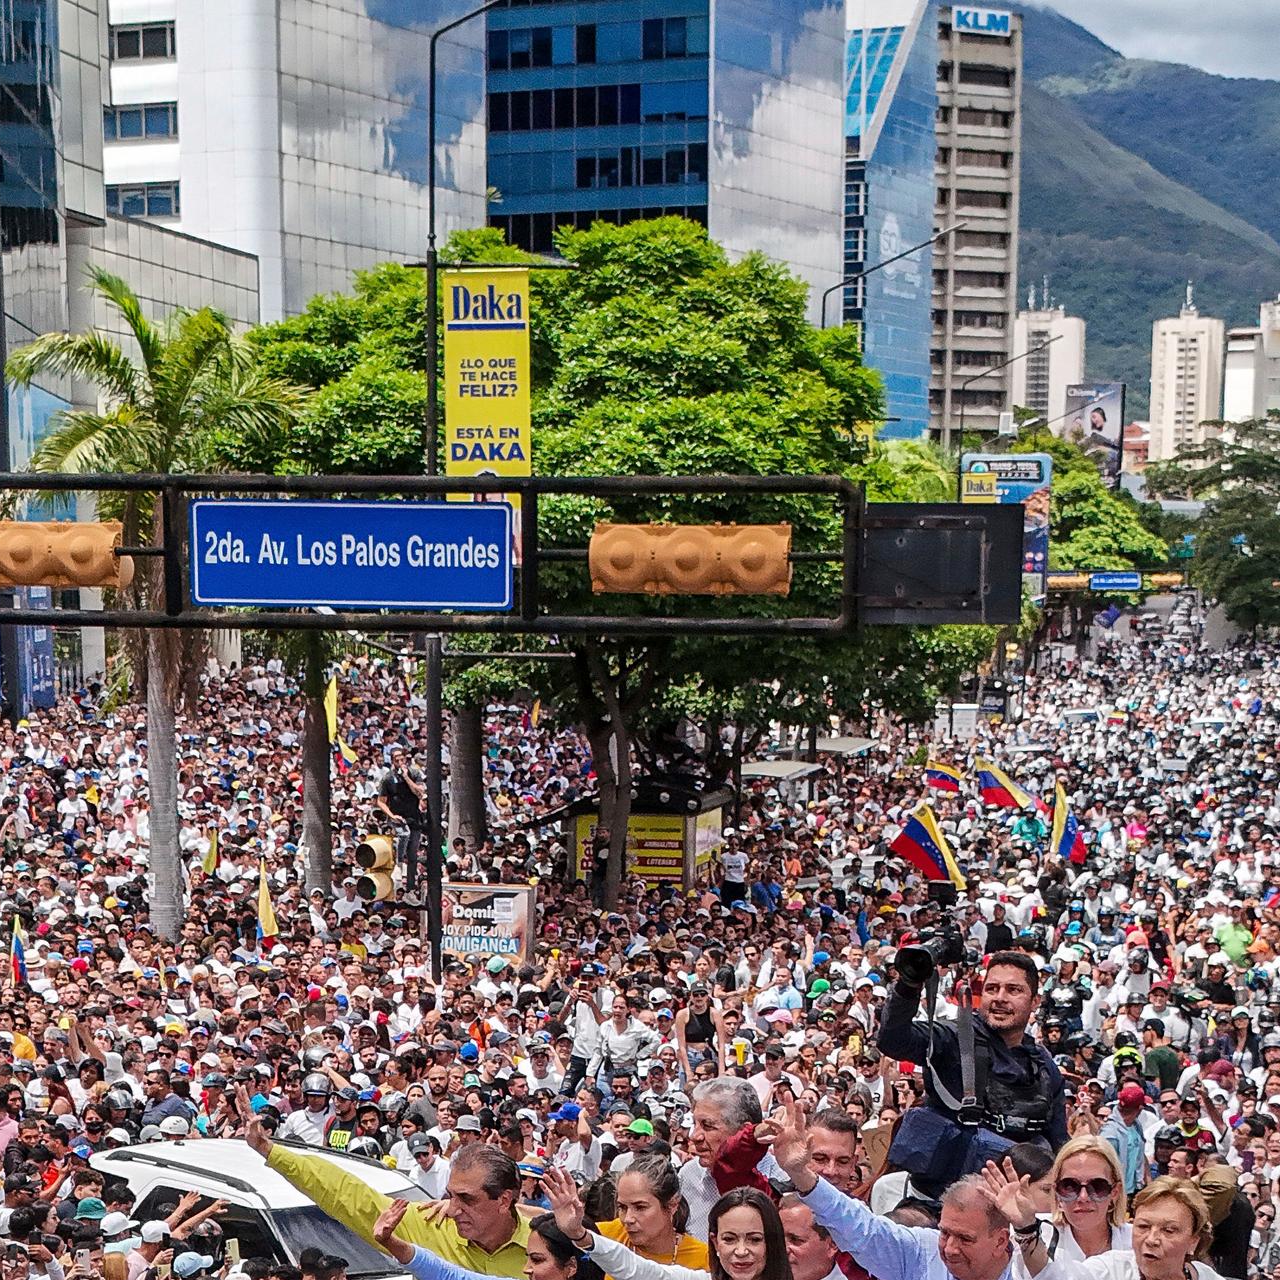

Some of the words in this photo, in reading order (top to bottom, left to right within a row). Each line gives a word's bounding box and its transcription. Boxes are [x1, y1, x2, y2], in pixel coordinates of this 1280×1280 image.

[956, 10, 1009, 33] KLM
[451, 285, 522, 320] Daka
[460, 359, 484, 369] ¿LO
[488, 359, 516, 368] QUE
[460, 372, 476, 381] TE
[480, 371, 517, 381] HACE
[459, 384, 517, 397] FELIZ?
[456, 425, 494, 439] ESTÁ
[499, 427, 519, 438] EN
[451, 442, 526, 462] DAKA
[966, 480, 993, 493] Daka
[205, 530, 250, 564] 2da.
[258, 533, 289, 565] Av.
[297, 534, 337, 566] Los
[341, 534, 401, 567] Palos
[407, 534, 500, 568] Grandes
[452, 904, 495, 919] Domi
[464, 925, 488, 937] PIDE
